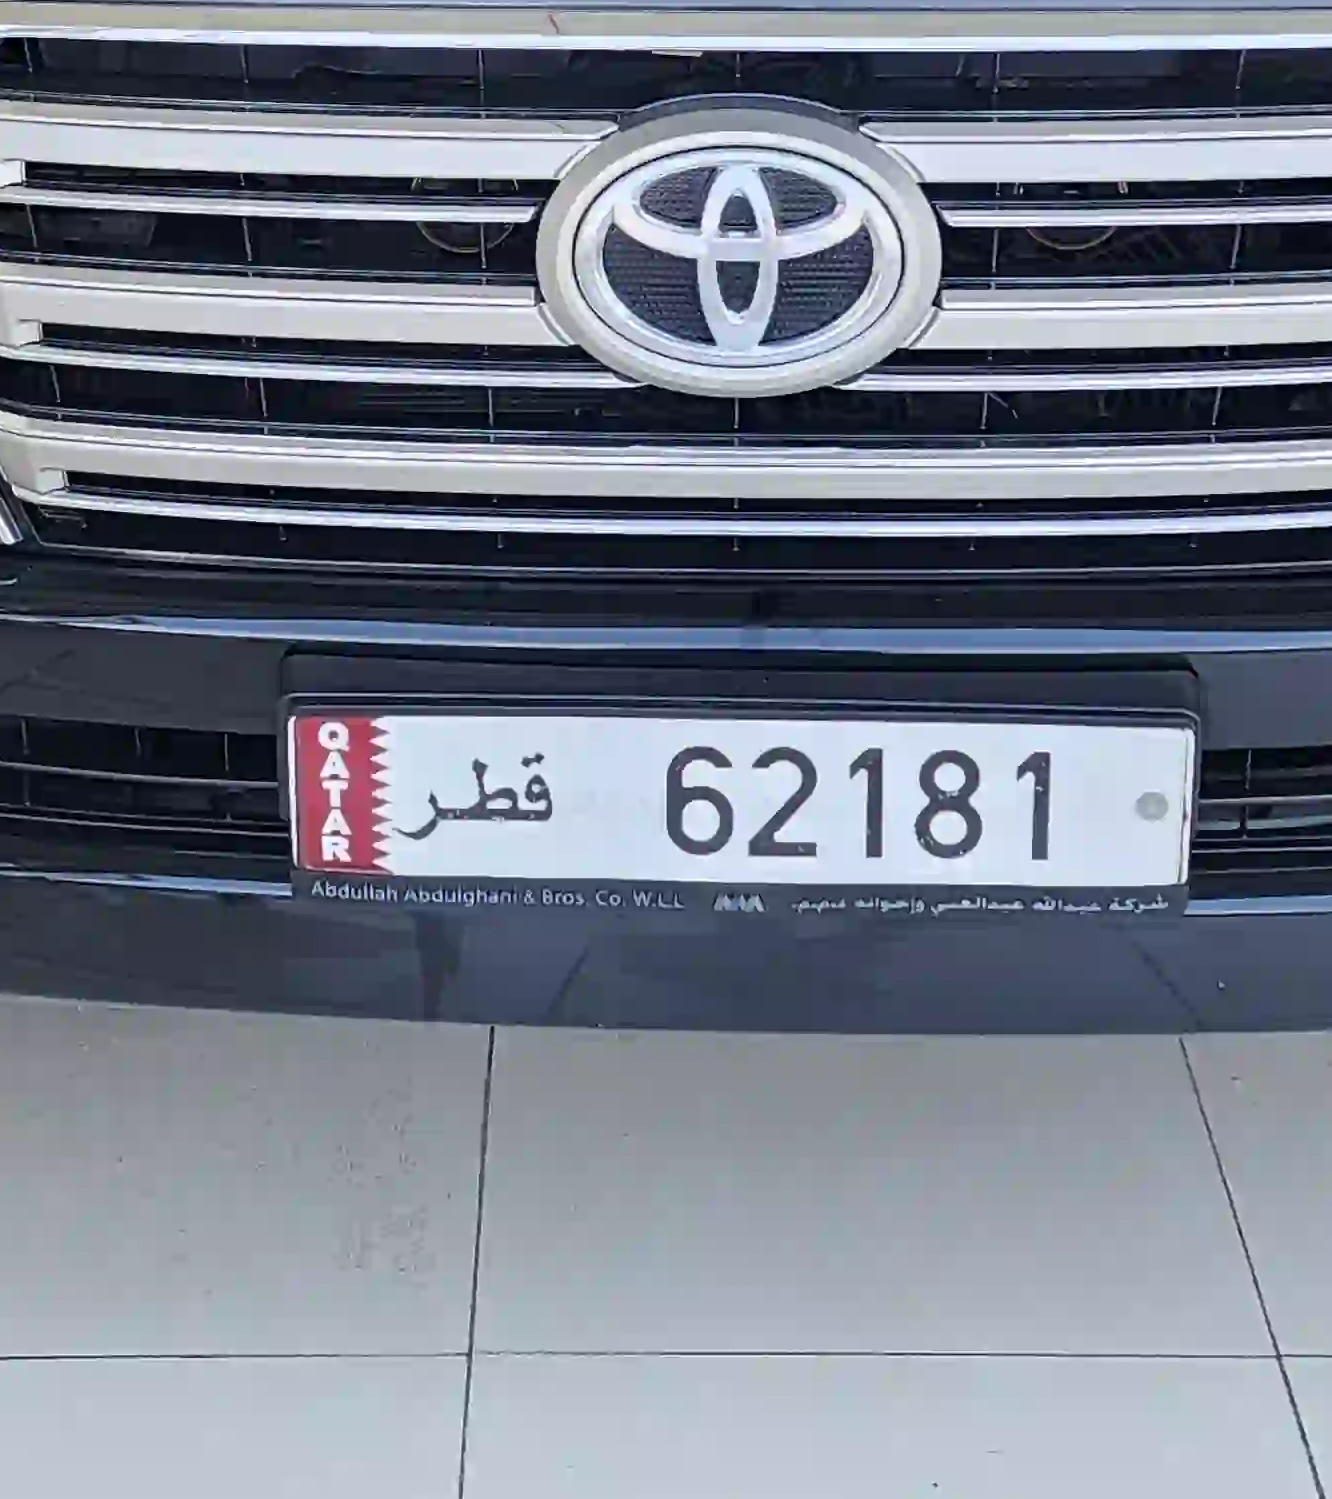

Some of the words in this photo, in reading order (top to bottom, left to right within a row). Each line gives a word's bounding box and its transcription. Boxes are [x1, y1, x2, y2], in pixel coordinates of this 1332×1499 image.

[318, 721, 353, 863] QATAR
[392, 752, 553, 841] قطر
[666, 745, 1051, 860] 62181
[311, 879, 398, 902] Abdullah
[403, 884, 518, 907] Abdulghani
[524, 889, 536, 905] &
[1109, 893, 1169, 914] شركة
